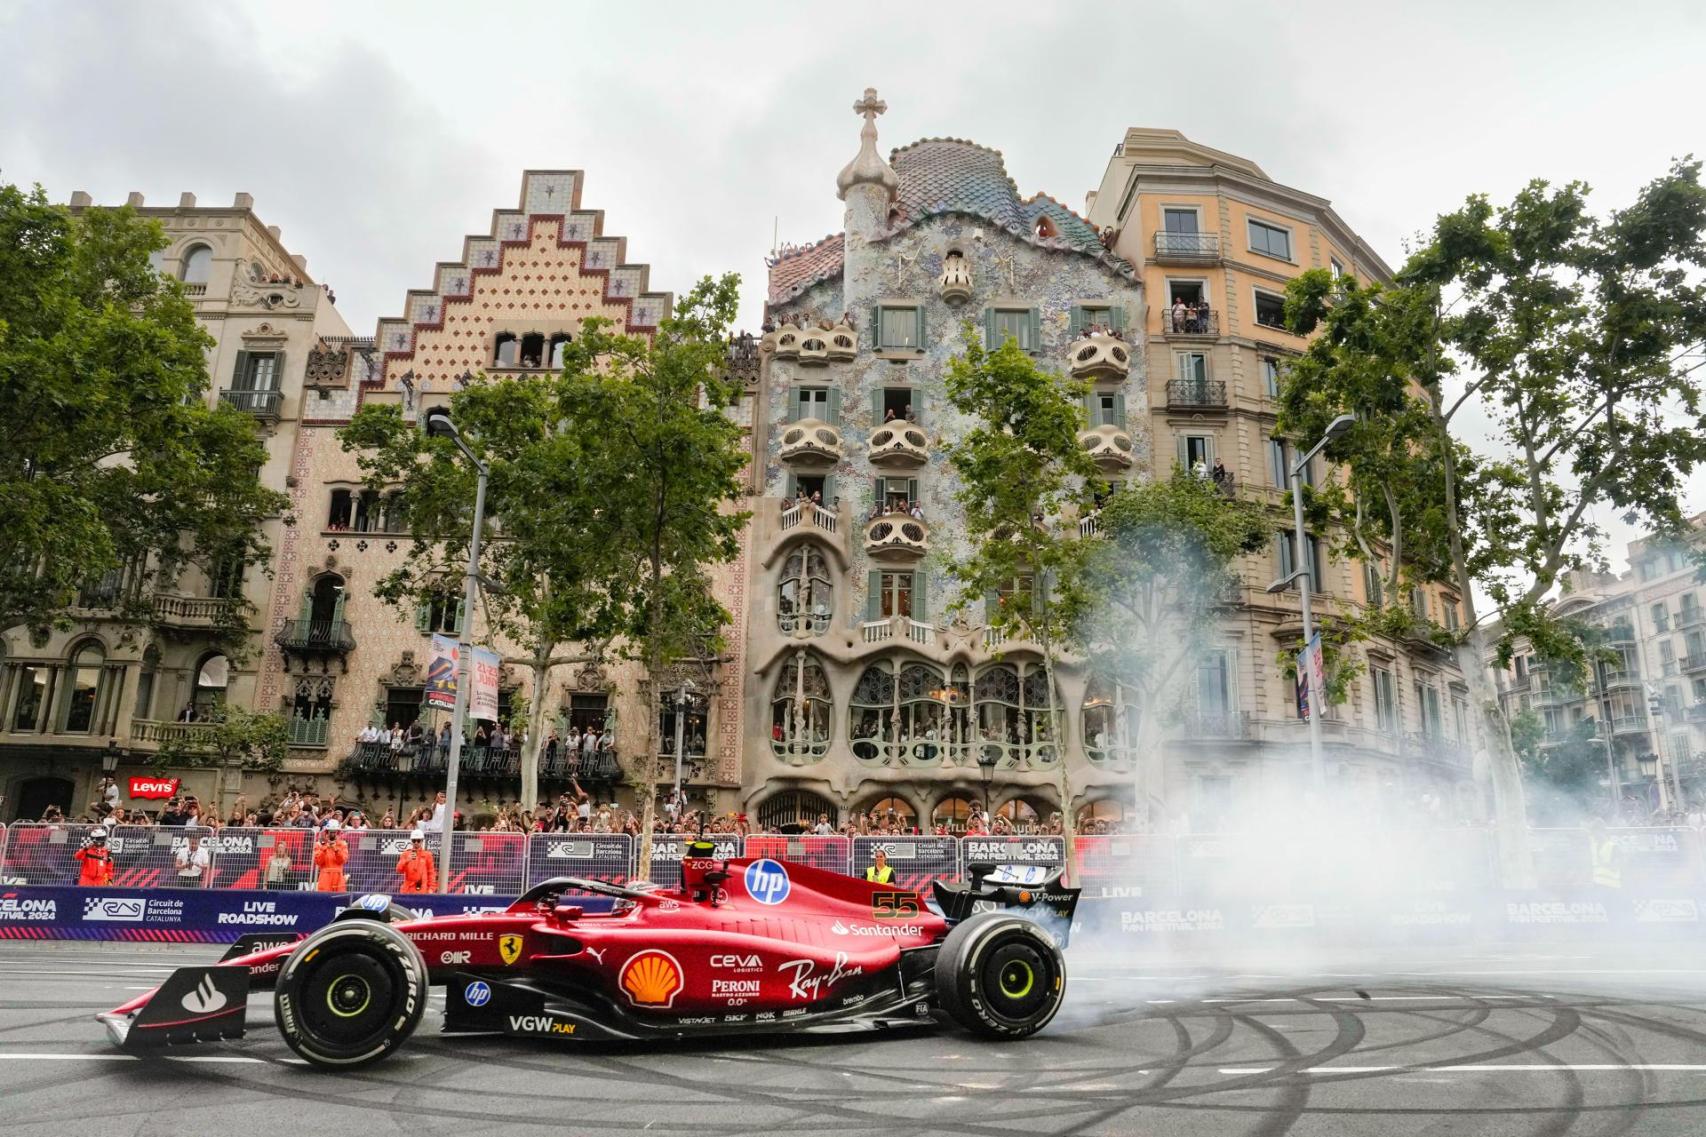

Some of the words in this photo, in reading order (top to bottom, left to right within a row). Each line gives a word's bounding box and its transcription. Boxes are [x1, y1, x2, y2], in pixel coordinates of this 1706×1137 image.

[172, 837, 252, 847] BACELONA
[148, 907, 182, 915] Barcelona
[244, 902, 276, 912] LIVE
[873, 892, 919, 920] 55
[28, 912, 56, 920] 2024
[218, 913, 298, 925] ROADSHOW
[406, 932, 456, 940] RICHARD
[460, 932, 494, 940] MILLE
[850, 924, 924, 937] Santander
[778, 951, 862, 1000] Ray-Ban
[712, 980, 760, 992] PERONI
[509, 1015, 553, 1032] VGW
[553, 1023, 576, 1033] PLAY
